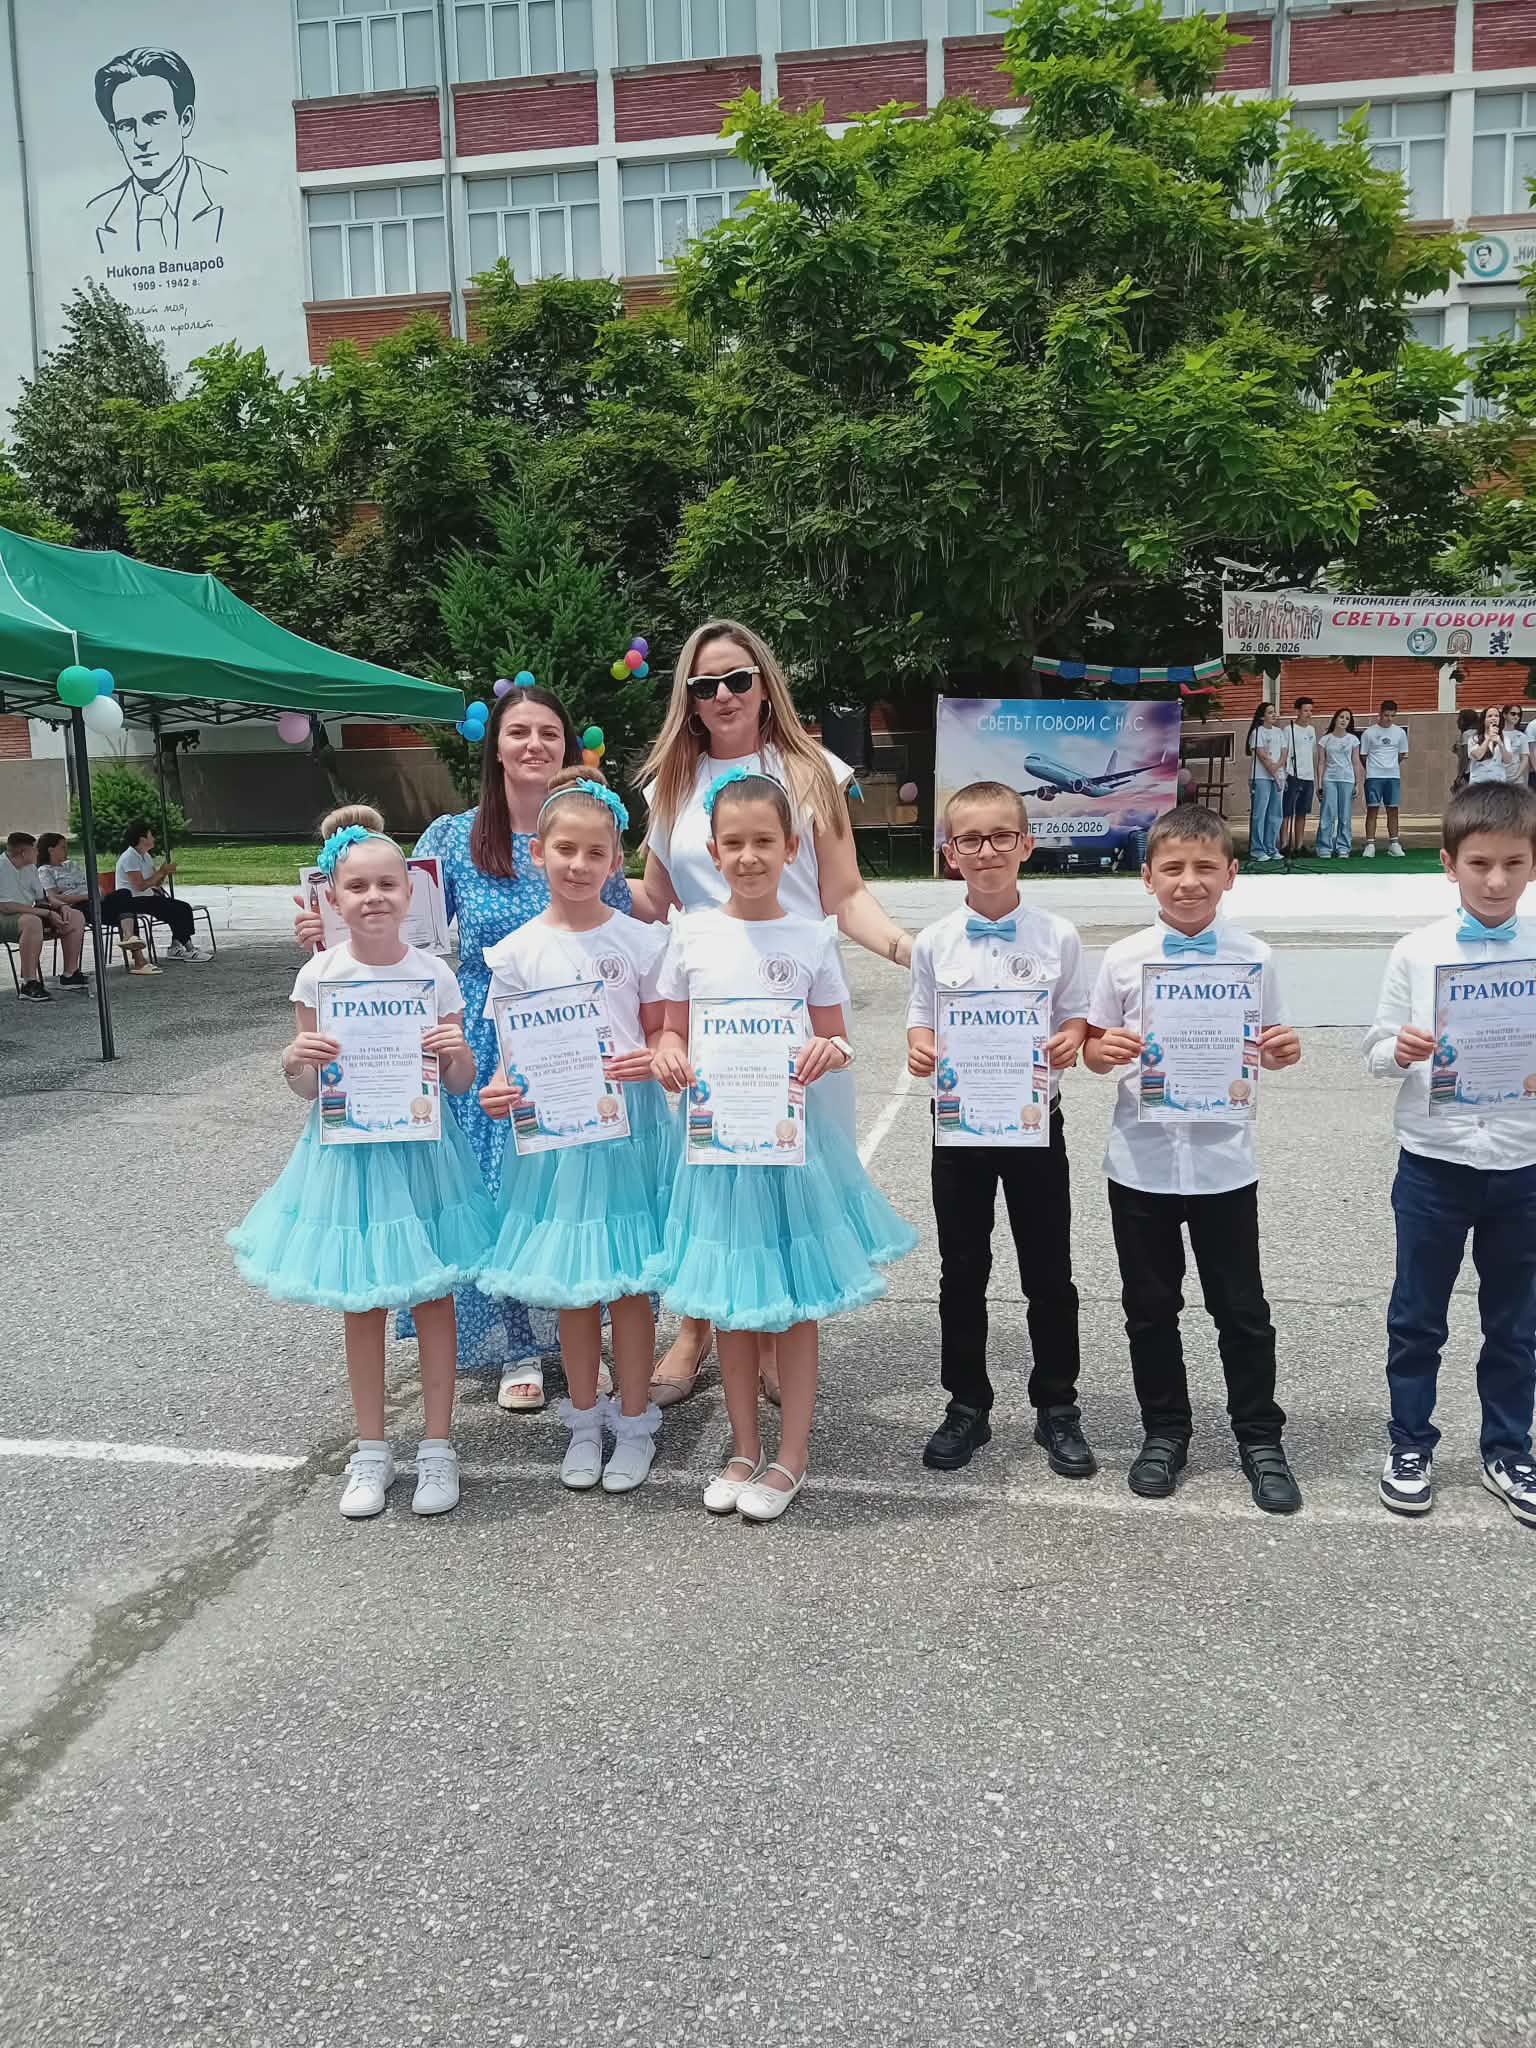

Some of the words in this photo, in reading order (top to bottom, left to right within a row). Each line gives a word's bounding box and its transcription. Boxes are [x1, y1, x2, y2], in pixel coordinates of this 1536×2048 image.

[106, 265, 155, 279] Никола
[159, 256, 224, 274] Вапцаров
[132, 281, 156, 291] 1909
[166, 278, 189, 288] 1942
[1332, 596, 1410, 607] РЕГИОНАЛЕН
[1412, 597, 1466, 607] ПРАЗНИК
[1470, 598, 1487, 607] НА
[1331, 610, 1416, 626] СВЕТЪТ
[1422, 611, 1516, 627] ГОВОРИ
[1522, 612, 1536, 628] С
[1239, 642, 1300, 653] 26.06.2026
[977, 714, 1032, 732] СВЕТЪТ
[1035, 714, 1095, 732] ГОВОРИ
[1099, 715, 1111, 731] С
[1115, 715, 1145, 732] НАС
[1155, 983, 1252, 1000] ГРАМОТА
[332, 1000, 427, 1017] ГРАМОТА
[509, 1002, 600, 1030] ГРАМОТА
[949, 1010, 1039, 1025] ГРАМОТА
[703, 1018, 796, 1035] ГРАМОТА
